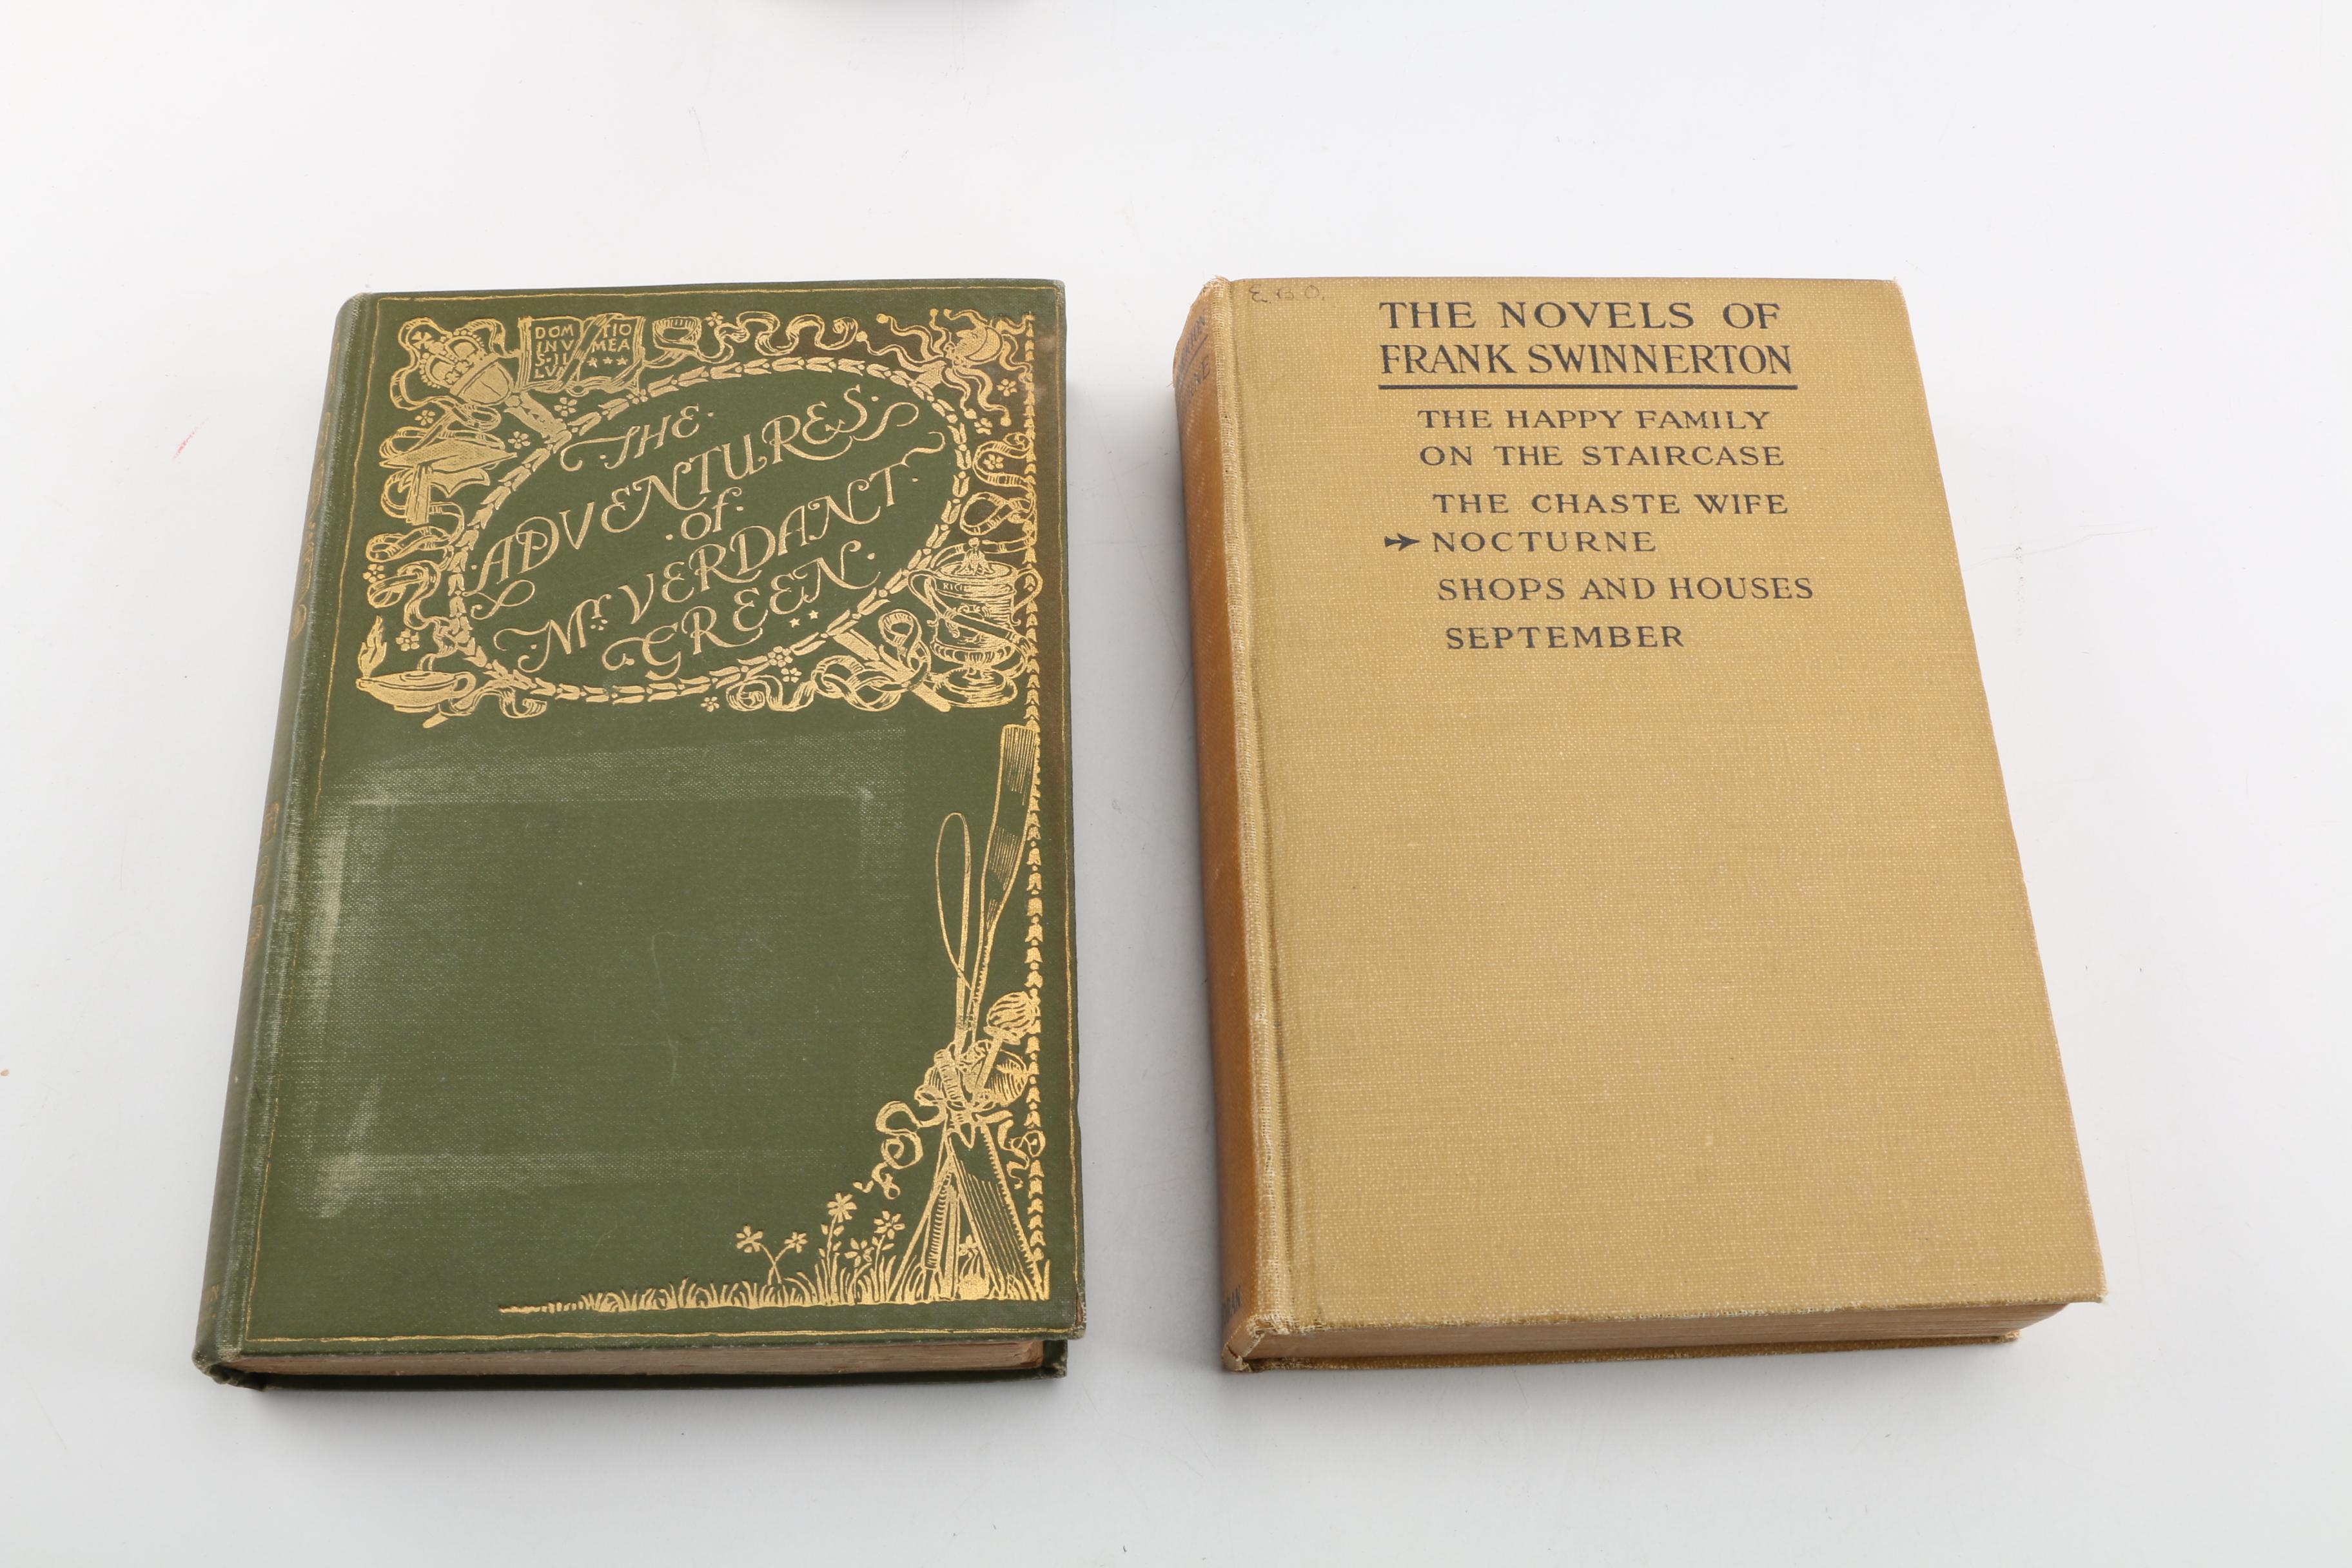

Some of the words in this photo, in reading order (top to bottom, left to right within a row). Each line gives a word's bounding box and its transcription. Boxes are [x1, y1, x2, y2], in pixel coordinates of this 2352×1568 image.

[1379, 302, 1476, 329] THE
[1498, 302, 1694, 329] NOVELS
[1723, 303, 1781, 329] OF
[1380, 344, 1517, 375] FRANK
[1528, 344, 1792, 375] SWINNERTON
[1417, 410, 1492, 429] THE
[1505, 409, 1623, 429] HAPPY
[1636, 410, 1770, 430] FAMILY
[560, 404, 700, 471] THE
[1420, 446, 1473, 466] ON
[1493, 446, 1563, 466] THE
[1582, 446, 1785, 466] STAIRCASE
[463, 385, 919, 620] ADVENTURES
[681, 486, 743, 540] of
[1433, 494, 1509, 514] THE
[1531, 493, 1680, 514] CHASTE
[1694, 494, 1788, 514] WIFE
[618, 431, 946, 624] VERDANT
[1432, 531, 1656, 553] NOCTURNE
[1438, 578, 1565, 600] SHOPS
[1580, 578, 1656, 600] AND
[1669, 577, 1814, 600] HOUSES
[602, 540, 881, 680] GREEN
[1446, 626, 1684, 650] SEPTEMBER
